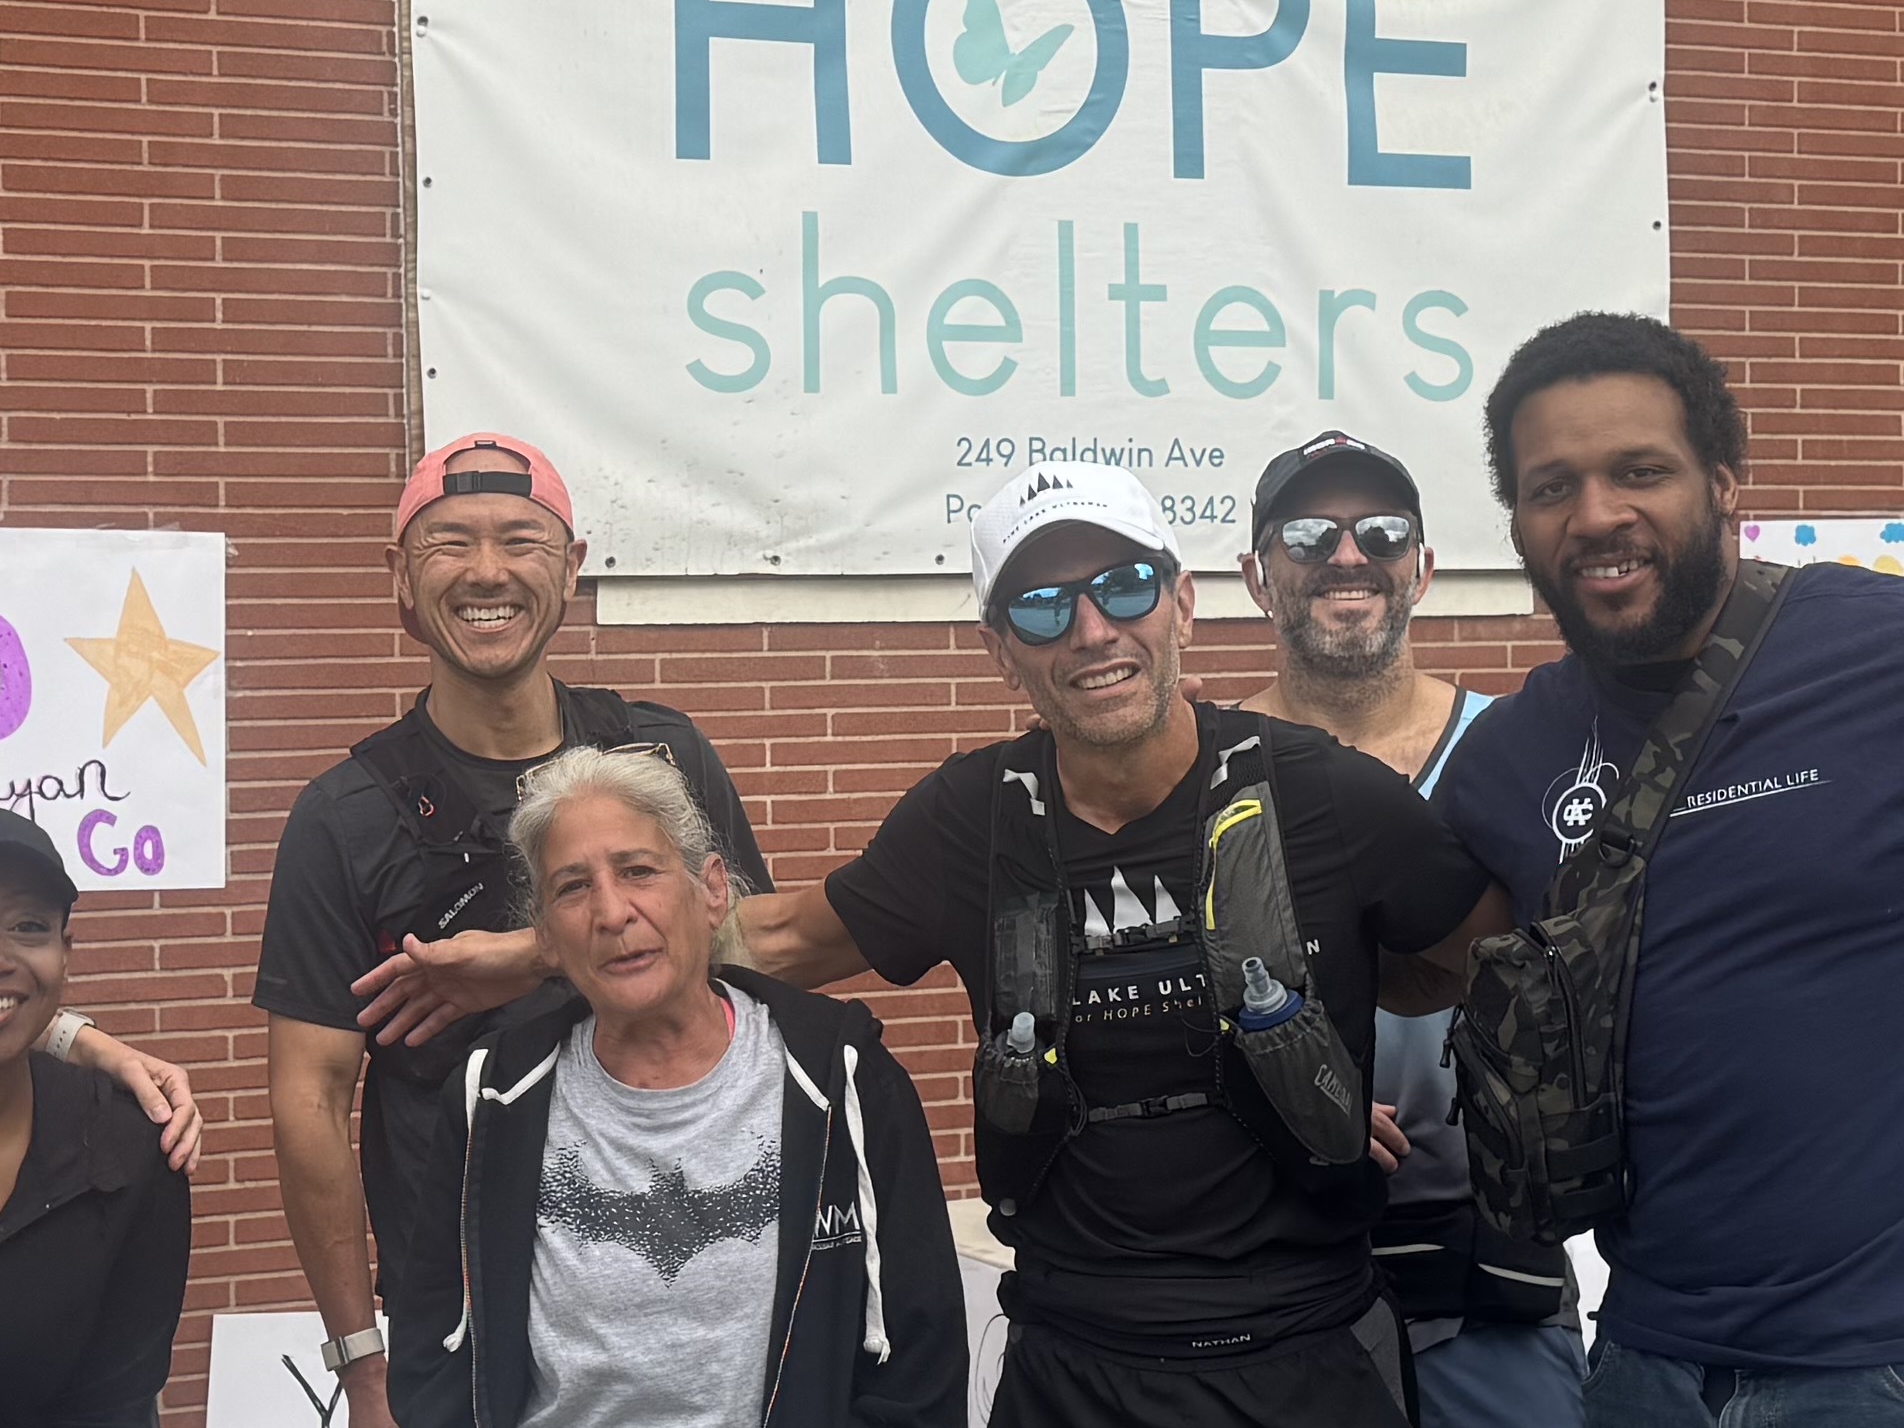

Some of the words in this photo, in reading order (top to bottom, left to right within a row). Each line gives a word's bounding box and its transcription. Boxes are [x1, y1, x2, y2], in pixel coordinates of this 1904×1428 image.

[685, 211, 1475, 403] shelters
[955, 436, 1016, 468] 249
[1028, 436, 1154, 468] Baldwin
[1164, 436, 1226, 468] Ave
[1686, 778, 1782, 808] RESIDENTIAL
[1786, 768, 1820, 787] LIFE
[77, 808, 165, 877] Go
[438, 882, 484, 930] SALOMON
[1103, 1003, 1152, 1021] HOPE
